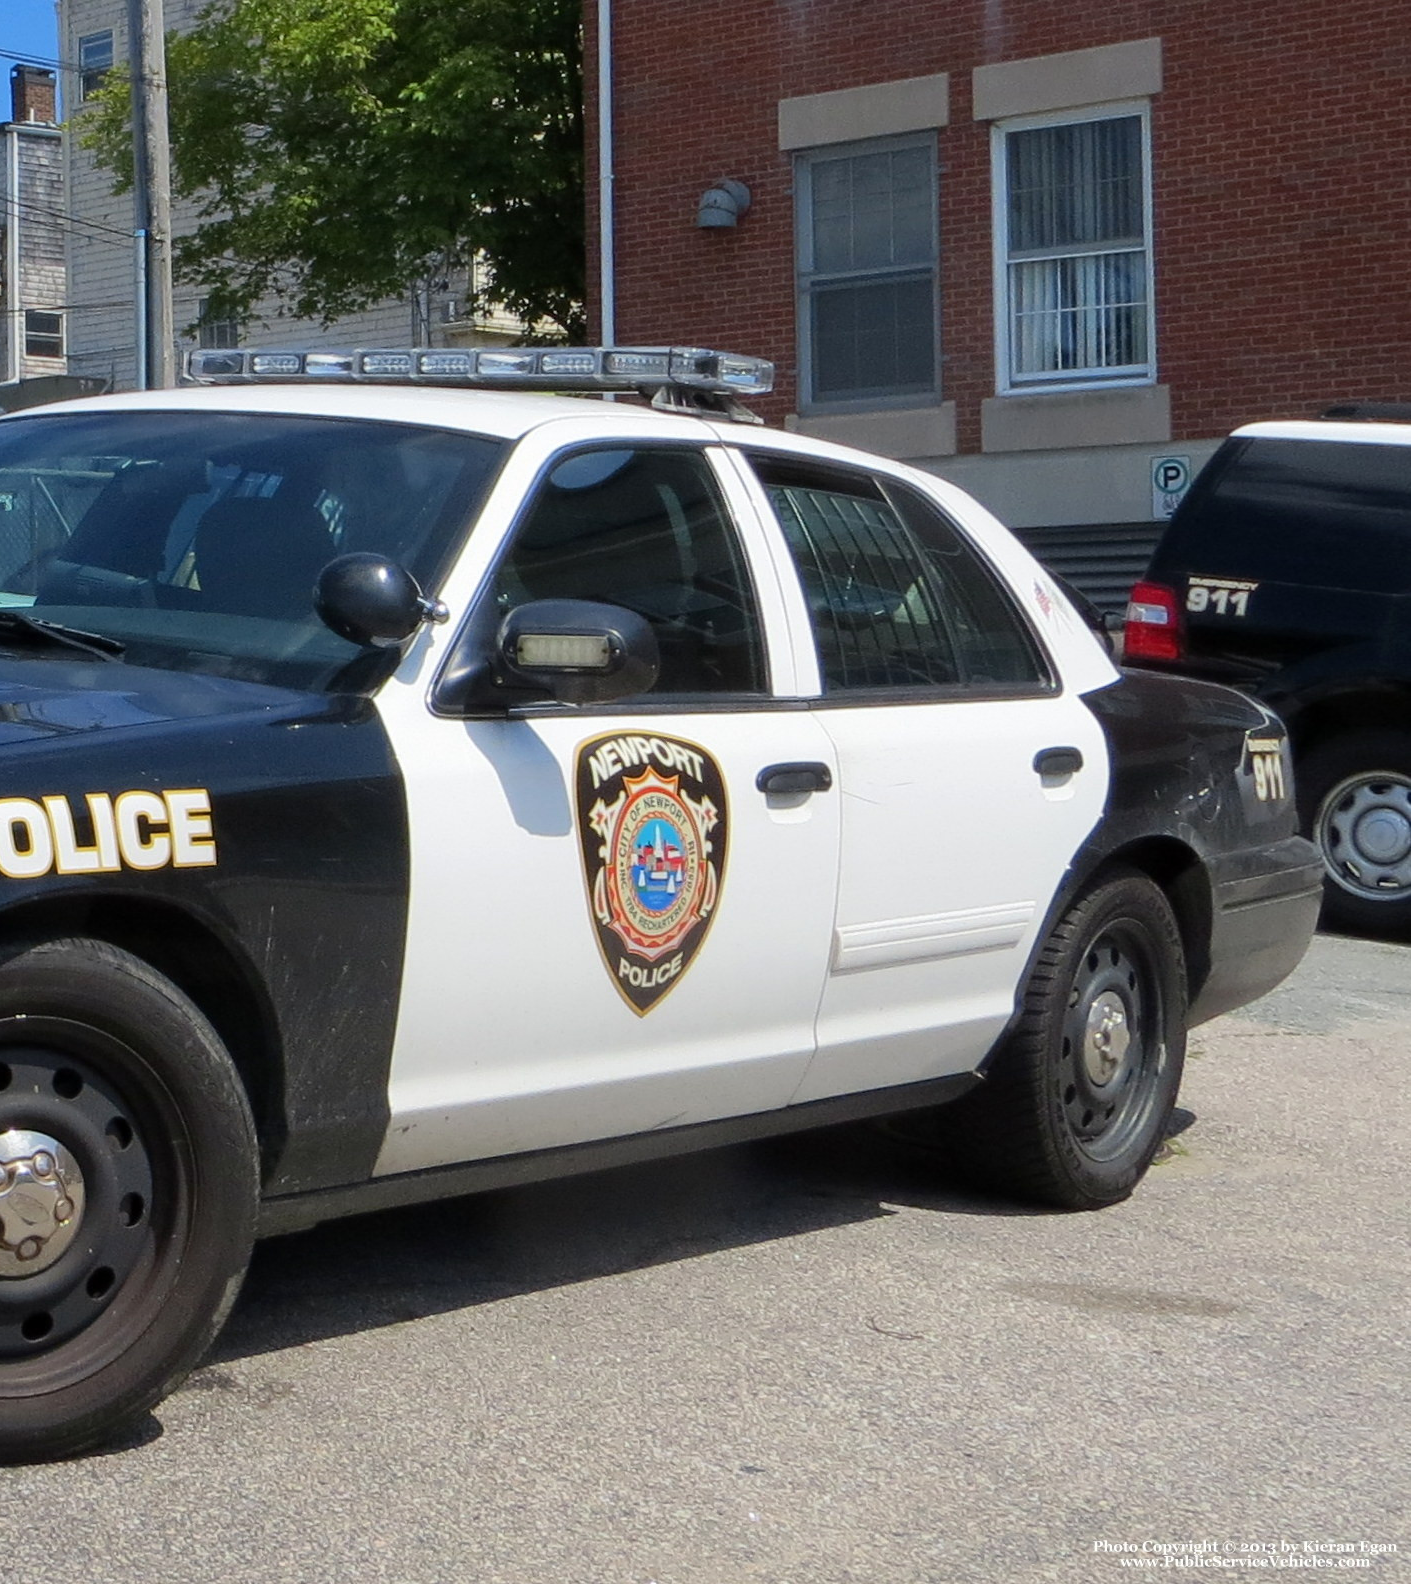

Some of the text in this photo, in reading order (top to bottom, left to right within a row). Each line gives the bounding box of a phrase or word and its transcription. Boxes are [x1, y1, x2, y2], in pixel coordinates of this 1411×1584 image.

[1163, 466, 1181, 488] P
[1186, 586, 1250, 616] 911
[588, 736, 705, 790] NEWPORT
[1252, 754, 1286, 801] 911
[619, 826, 632, 858] CITY
[630, 803, 642, 822] OF
[643, 796, 687, 827] NEWPORT
[619, 951, 684, 988] POLICE
